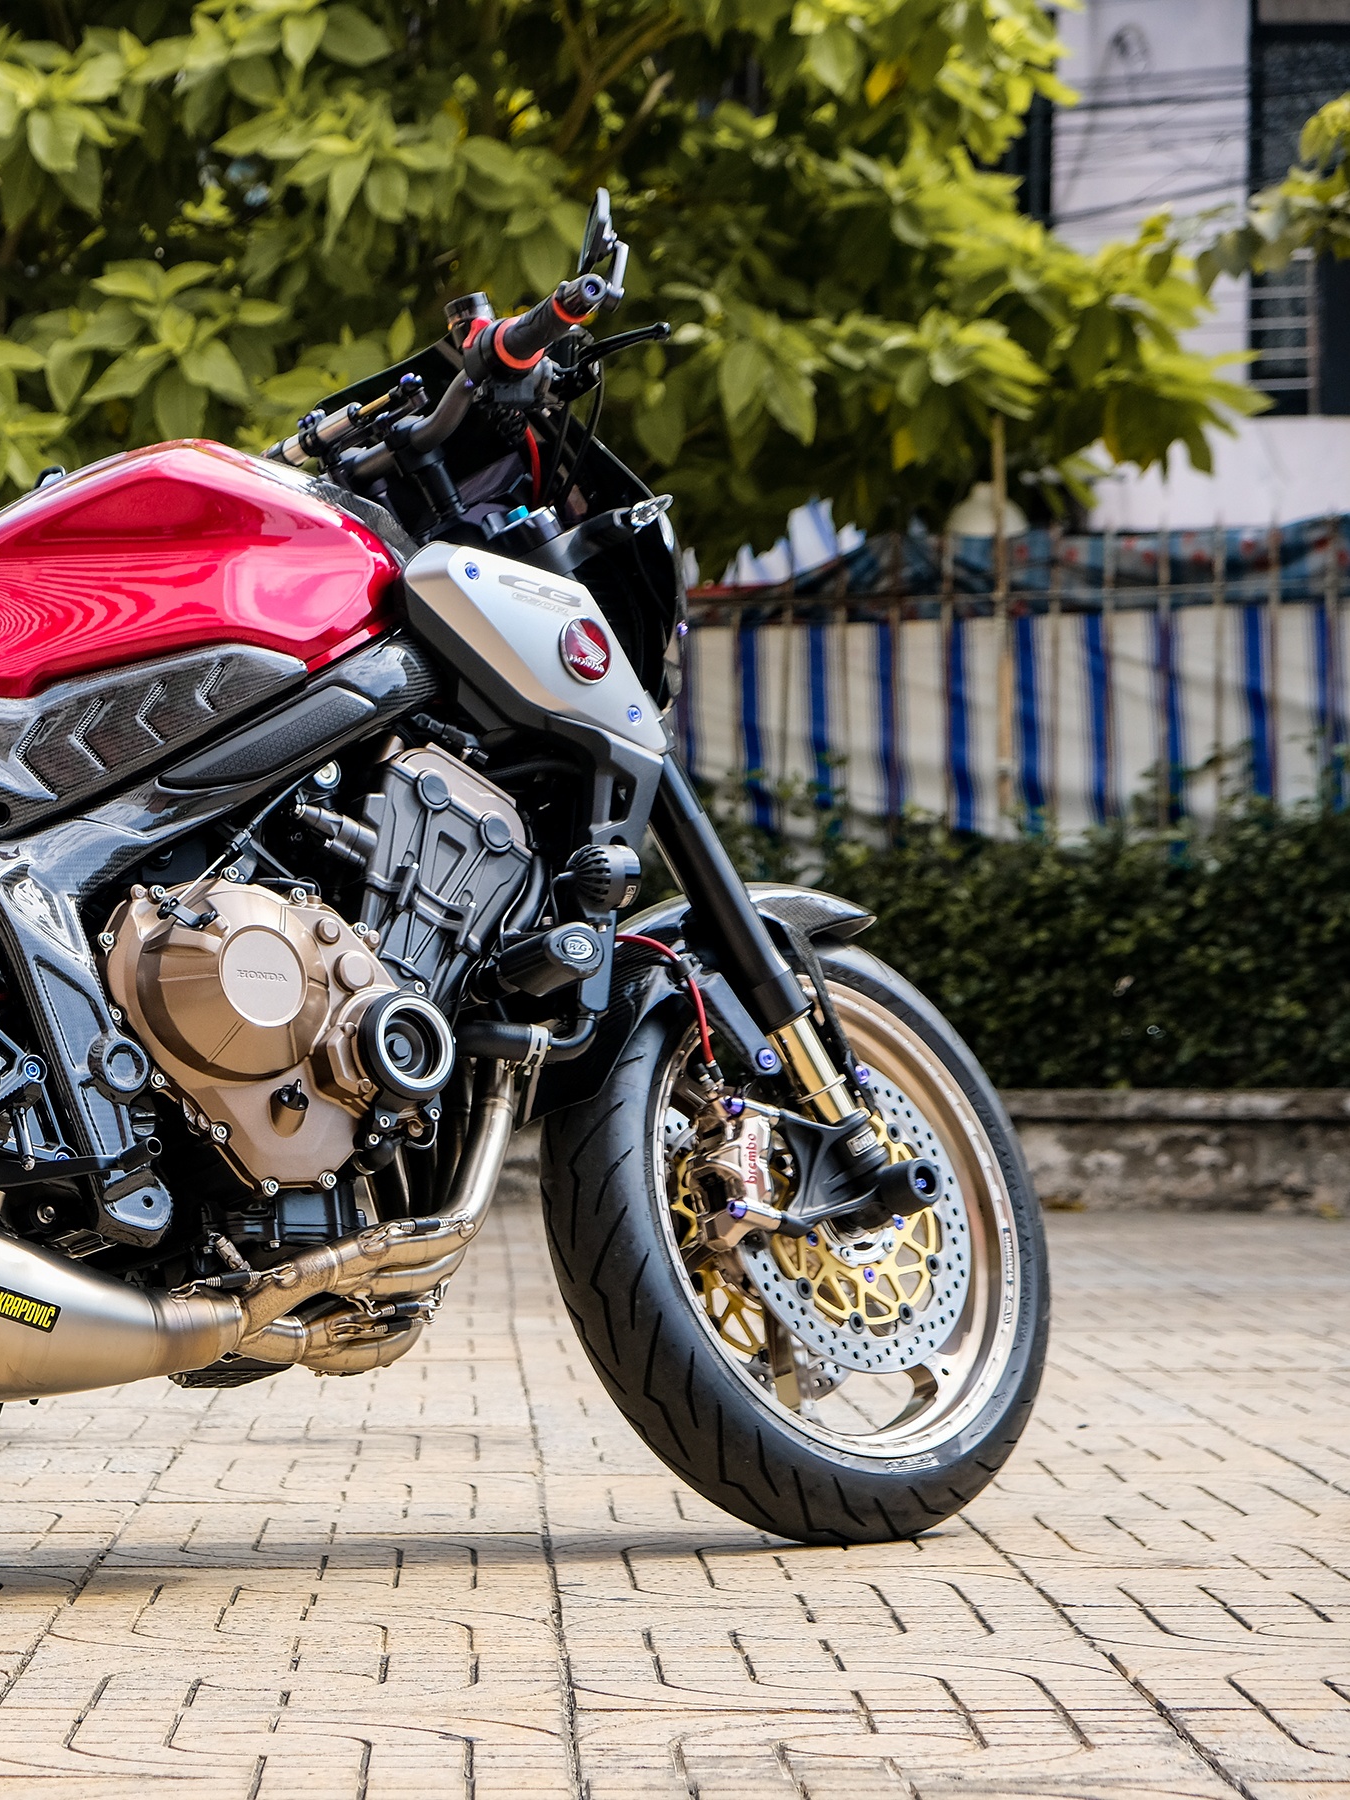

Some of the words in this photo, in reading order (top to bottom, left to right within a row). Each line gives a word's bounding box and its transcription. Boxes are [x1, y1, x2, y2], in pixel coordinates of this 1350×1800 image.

[568, 653, 606, 675] HONDA
[236, 968, 288, 983] HONDA
[744, 1133, 759, 1185] brembo
